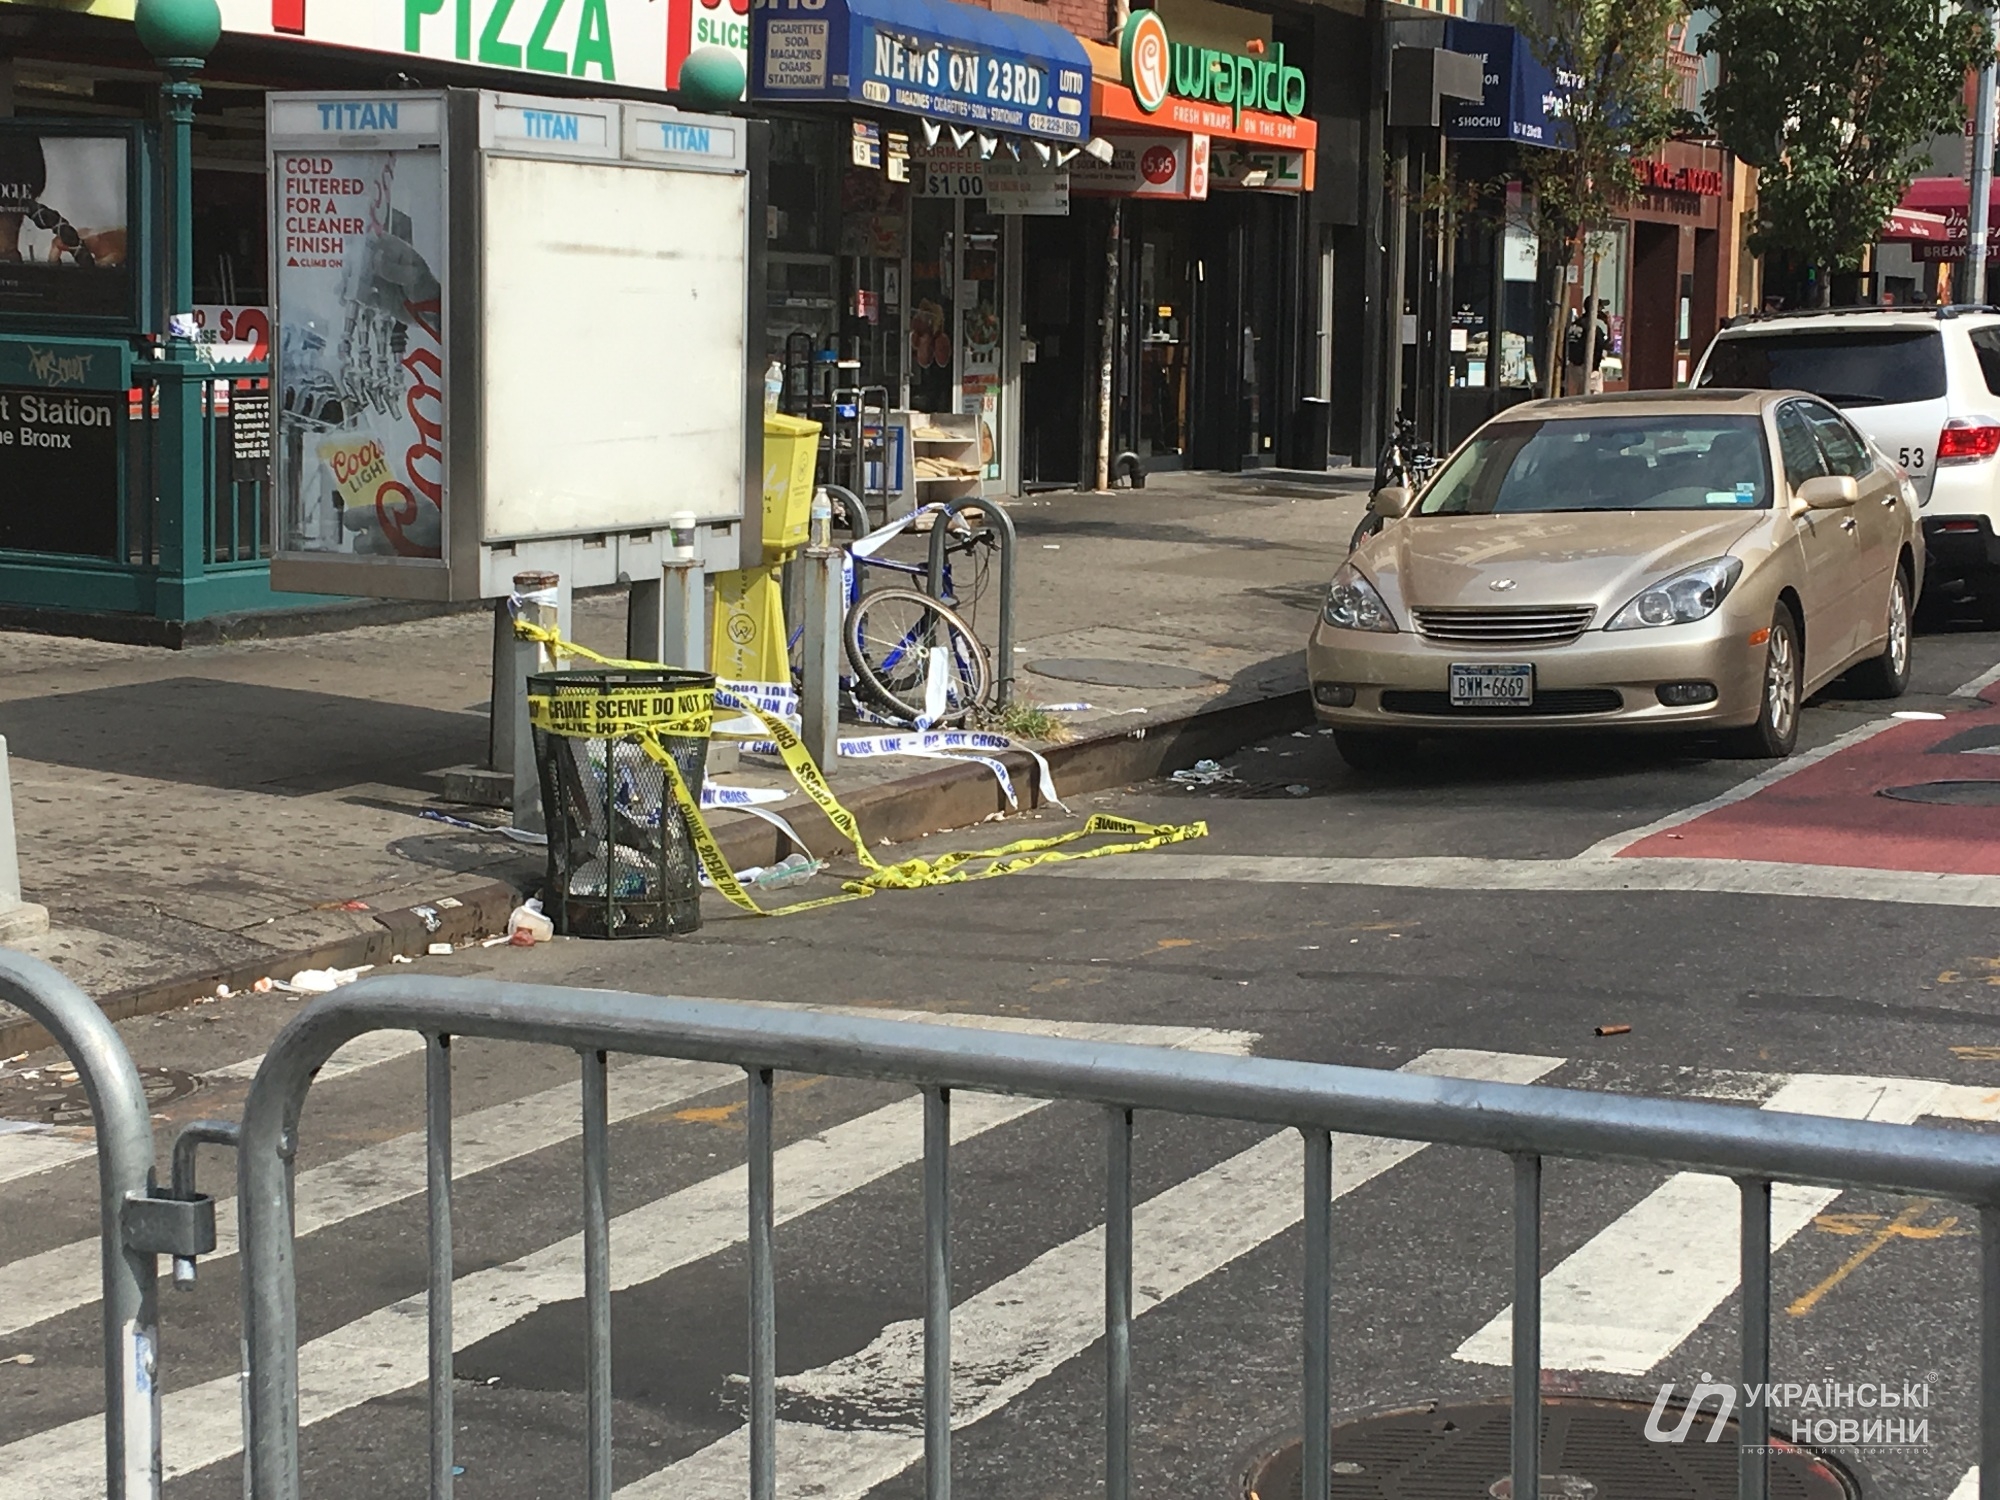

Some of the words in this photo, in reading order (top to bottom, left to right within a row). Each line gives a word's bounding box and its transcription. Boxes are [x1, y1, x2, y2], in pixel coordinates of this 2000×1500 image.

[770, 24, 824, 34] CIGARETTES
[404, 0, 617, 82] PIZZA
[785, 37, 809, 47] SODA
[770, 49, 822, 60] MAGAZINES
[778, 62, 812, 72] CIGARS
[874, 33, 940, 88] NEWS
[949, 53, 980, 95] ON
[986, 58, 1041, 106] 23RD
[768, 74, 822, 85] STATIONARY
[1059, 70, 1084, 95] LOTTO
[1172, 38, 1306, 130] wrapido
[895, 88, 931, 110] MAGAZINES
[317, 103, 399, 130] TITAN
[523, 110, 579, 142] TITAN
[1173, 106, 1200, 125] FRESH
[1202, 110, 1231, 130] WRAPS
[1244, 119, 1257, 134] ON
[1259, 121, 1275, 136] THE
[1277, 124, 1297, 139] SPOT
[1458, 116, 1501, 127] SHOCHU
[660, 123, 711, 153] TITAN
[285, 158, 333, 175] COLD
[929, 161, 982, 173] COFFEE
[285, 178, 365, 196] FILTERED
[928, 175, 983, 196] $1.00
[285, 198, 321, 214] FOR
[325, 199, 338, 215] A
[285, 217, 365, 235] CLEANER
[285, 237, 344, 254] FINISH
[300, 258, 327, 269] CLIMB
[328, 258, 344, 269] ON
[20, 394, 111, 427] Station
[20, 426, 72, 449] Bronx
[1898, 447, 1925, 468] 53
[349, 458, 388, 494] LIGHT
[548, 700, 591, 719] CRIME
[595, 698, 648, 719] SCENE
[652, 696, 674, 716] DO
[678, 693, 700, 713] NOT
[839, 741, 873, 756] POLICE
[880, 738, 902, 752] LINE
[924, 734, 940, 748] DO
[944, 733, 967, 746] NOT
[971, 733, 1011, 748] CROSS
[718, 789, 753, 803] CROSS
